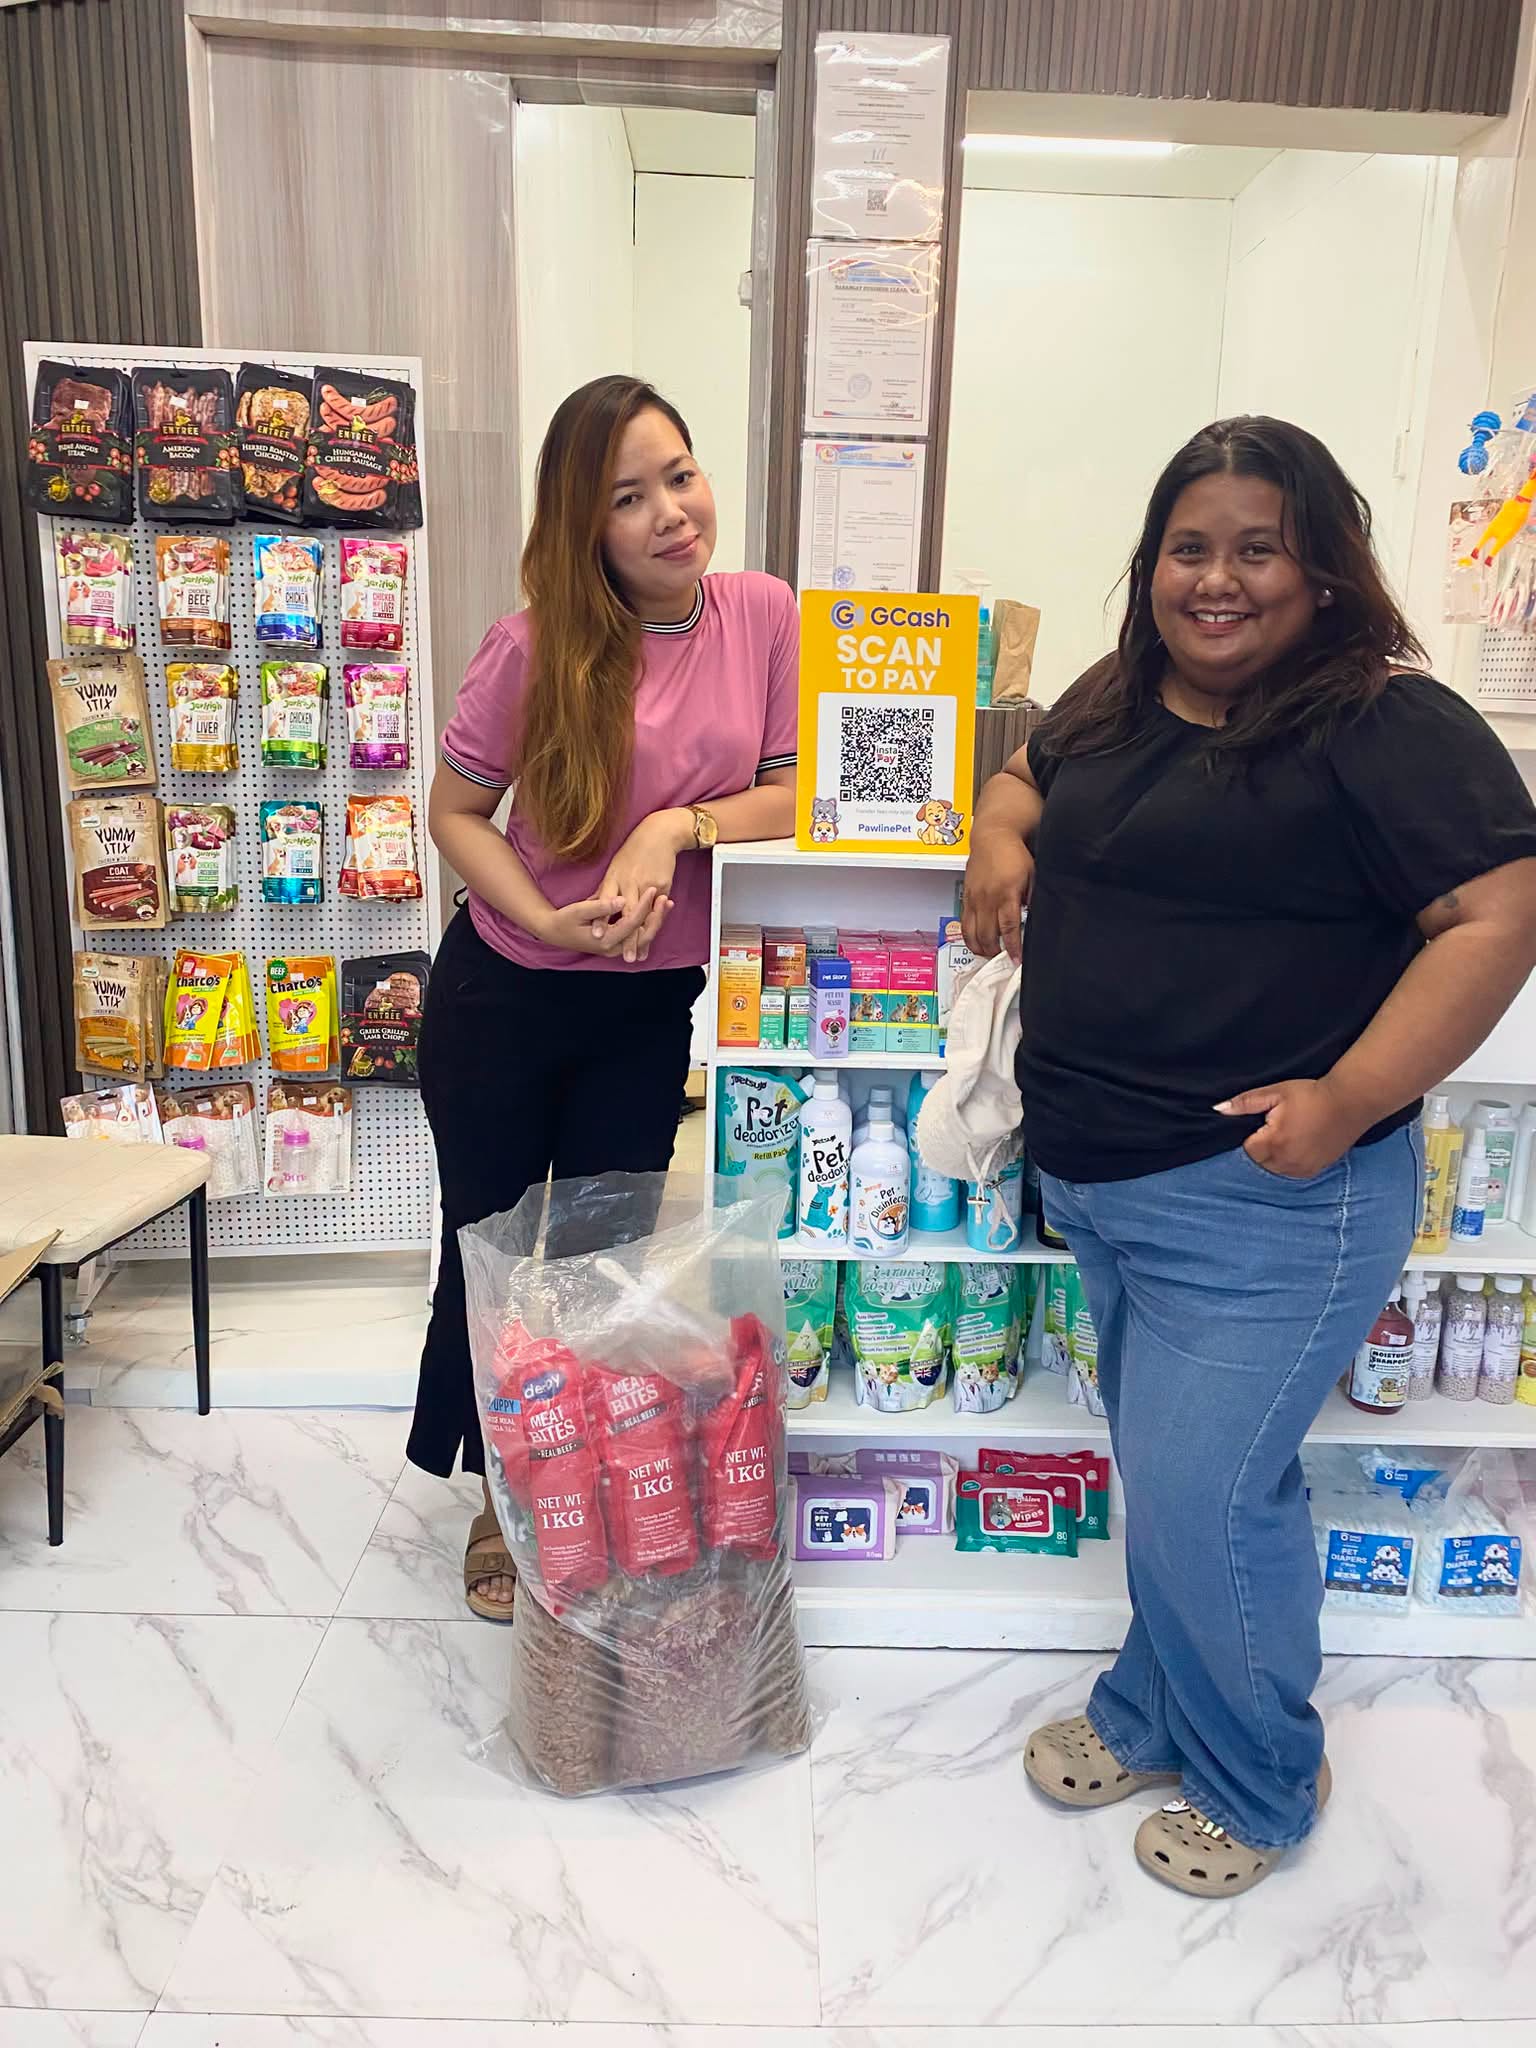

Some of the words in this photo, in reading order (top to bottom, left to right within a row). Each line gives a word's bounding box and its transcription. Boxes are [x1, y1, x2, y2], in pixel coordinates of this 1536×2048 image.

[162, 446, 201, 454] AMERICAN
[254, 450, 284, 462] CHICKEN
[269, 445, 299, 462] ROASTED
[332, 448, 377, 462] HUNGARIAN
[324, 454, 351, 464] CHEESE
[351, 457, 383, 472] SAUSAGE
[188, 594, 211, 605] BEEF
[381, 602, 395, 613] LIVER
[871, 607, 950, 628] GCash
[837, 635, 942, 666] SCAN
[841, 668, 876, 689] TO
[883, 670, 937, 690] PAY
[75, 682, 117, 701] YUMM
[86, 699, 112, 713] STIX
[289, 712, 313, 723] CHICKEN
[196, 723, 219, 734] LIVER
[876, 745, 898, 755] insta
[877, 754, 896, 765] Pay
[858, 823, 912, 833] PawlinePet
[95, 827, 135, 843] YUMM
[105, 842, 130, 855] STIX
[109, 867, 129, 876] COAT
[270, 967, 285, 975] BEEF
[93, 981, 126, 998] YUMM
[270, 976, 322, 994] Charco's
[99, 995, 121, 1008] STIX
[359, 1028, 380, 1036] GREEK
[381, 1028, 410, 1037] GRILLED
[382, 1033, 405, 1042] CHOPS
[747, 1096, 787, 1131] Pet
[734, 1115, 800, 1143] deodorizer
[754, 1152, 772, 1160] Refill
[813, 1141, 845, 1174] Pet
[880, 1187, 895, 1199] Pet
[612, 1376, 646, 1396] MEAT
[610, 1384, 658, 1416] BITES
[530, 1405, 564, 1428] MEAT
[624, 1416, 641, 1428] REAL
[641, 1408, 657, 1420] BEEF
[528, 1419, 576, 1443] BITES
[541, 1448, 557, 1458] REAL
[558, 1443, 574, 1455] BEEF
[726, 1450, 747, 1464] NET
[750, 1446, 767, 1459] WT.
[629, 1464, 650, 1480] NET
[654, 1458, 673, 1473] WT.
[537, 1496, 561, 1509] NET
[564, 1493, 586, 1507] WT.
[1011, 1509, 1045, 1522] Wipes
[1088, 1516, 1099, 1526] 80
[1056, 1531, 1068, 1541] 80
[1331, 1553, 1368, 1564] DIAPERS
[1341, 1548, 1358, 1556] PET
[1455, 1553, 1469, 1561] PET
[1445, 1560, 1478, 1570] DIAPERS
